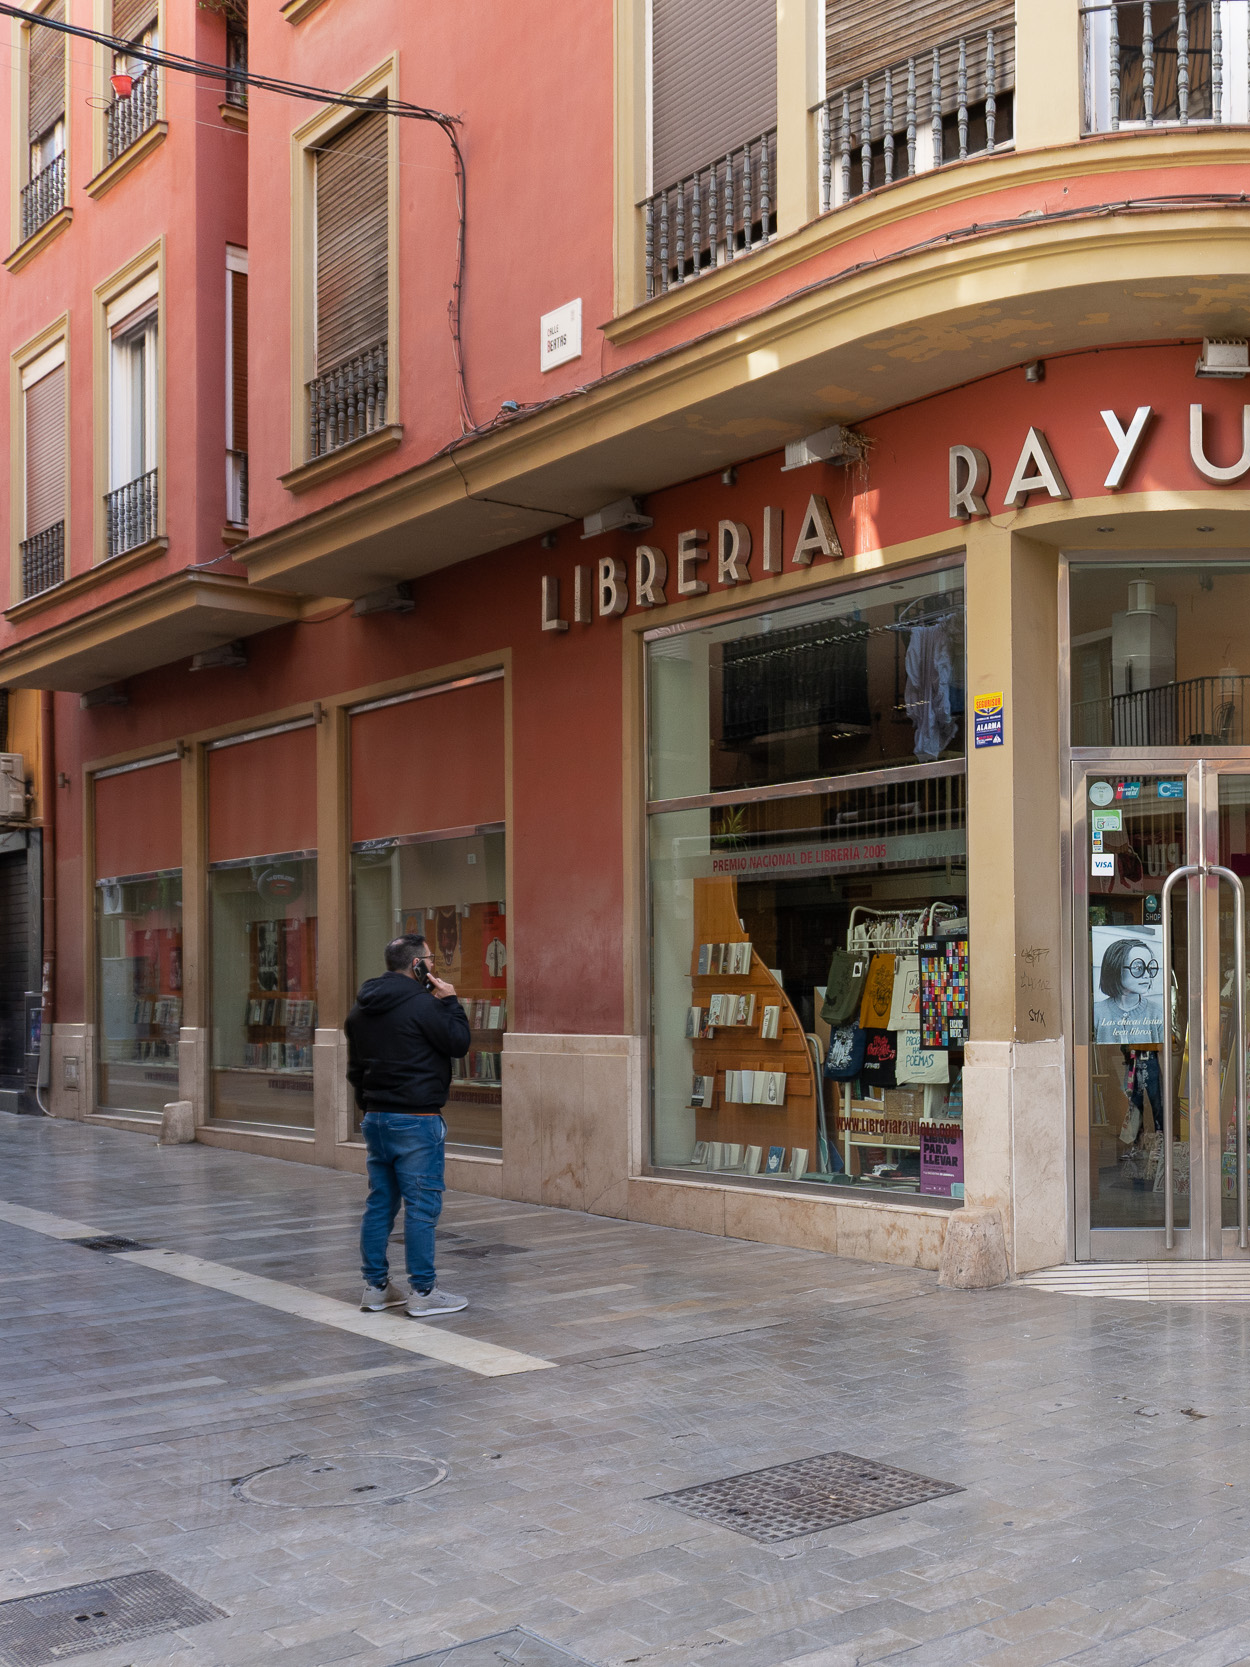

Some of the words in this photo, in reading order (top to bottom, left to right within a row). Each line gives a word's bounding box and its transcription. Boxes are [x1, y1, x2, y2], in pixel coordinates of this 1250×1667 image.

[547, 324, 559, 336] CALLE
[541, 494, 843, 631] LIBRERIA
[976, 721, 1001, 732] ALARMA
[712, 857, 747, 872] PREMIO
[749, 853, 797, 869] NACIONAL
[800, 851, 813, 864] DE
[815, 844, 860, 863] LIBRERÍA
[863, 844, 887, 859] 2005
[1095, 861, 1112, 869] VISA
[1101, 1017, 1115, 1026] Las
[1117, 1017, 1141, 1026] chicas
[1142, 1016, 1163, 1025] listas
[1112, 1027, 1128, 1036] leen
[1130, 1027, 1152, 1036] libros
[905, 1054, 934, 1068] POEMAS
[923, 1143, 948, 1155] PARA
[923, 1154, 958, 1167] LLEVAR
